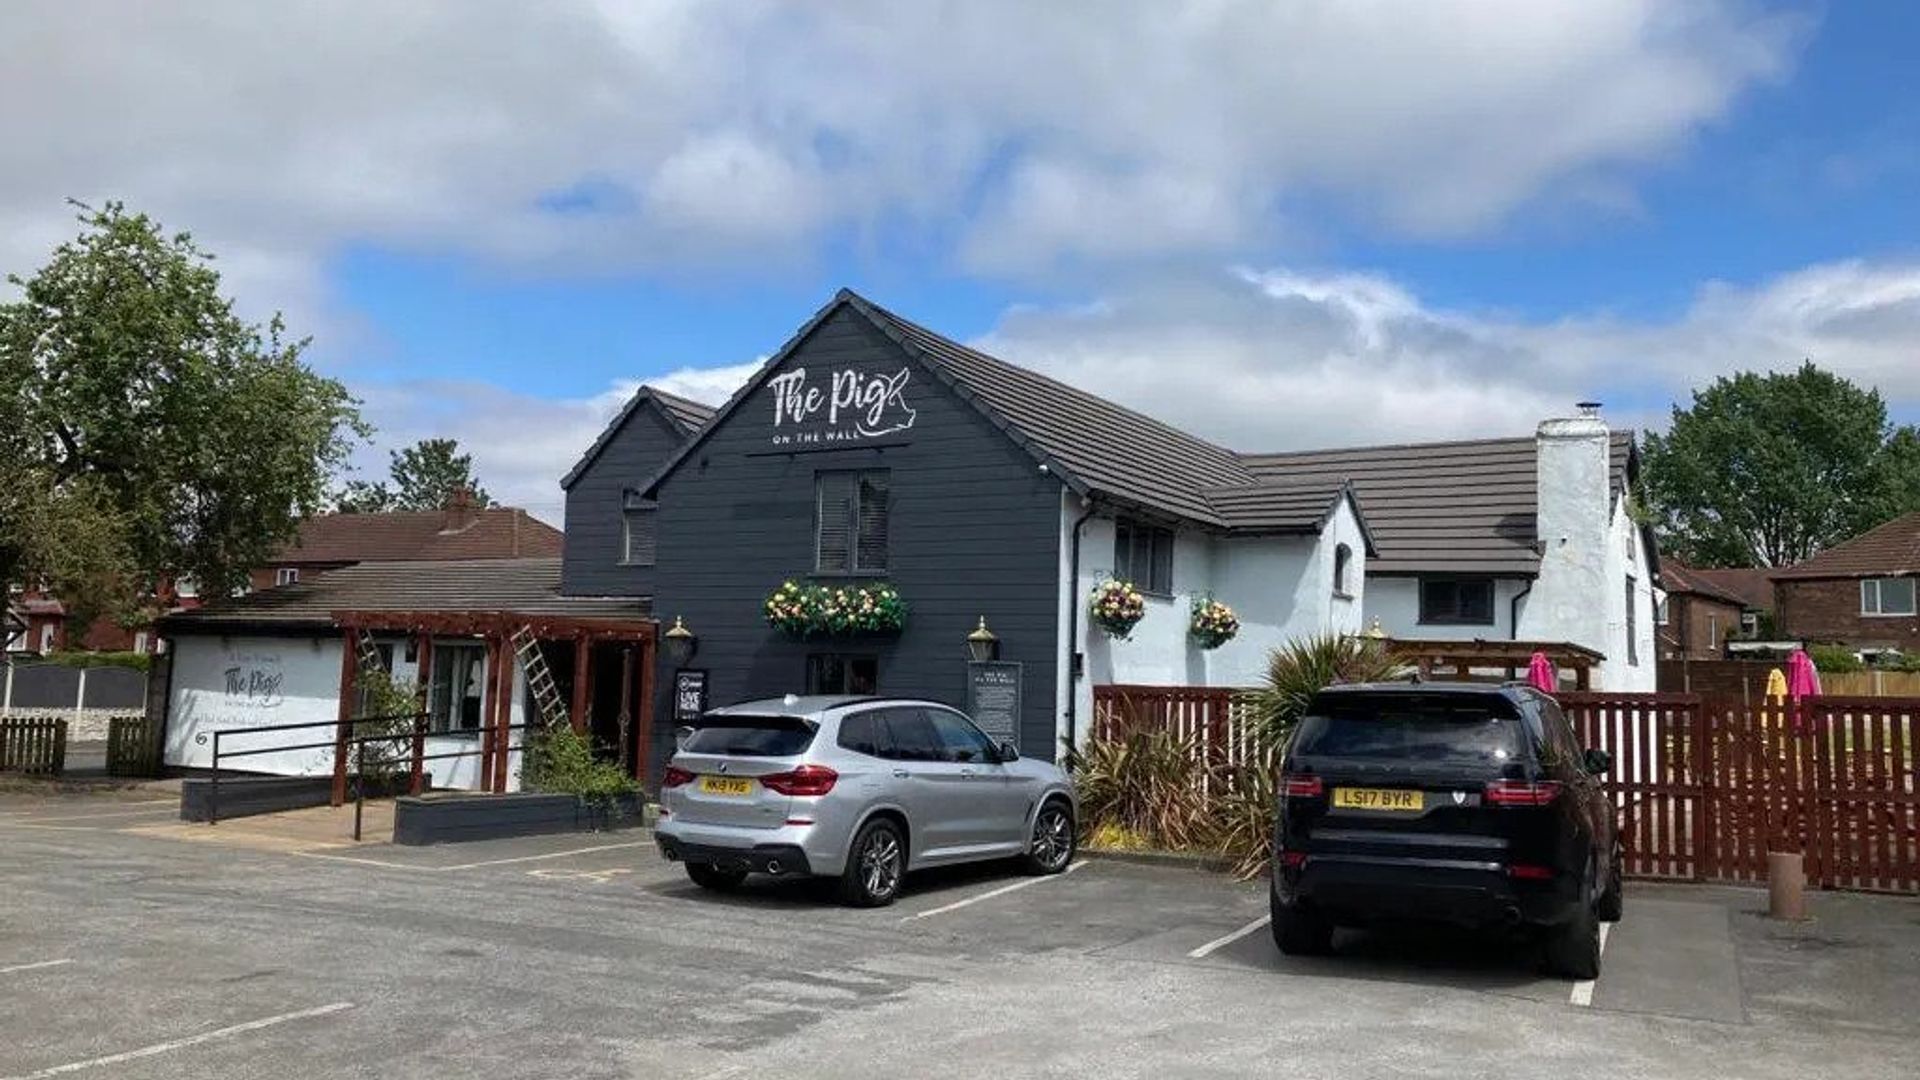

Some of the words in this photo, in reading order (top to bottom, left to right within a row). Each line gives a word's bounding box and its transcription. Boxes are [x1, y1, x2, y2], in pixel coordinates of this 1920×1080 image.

[767, 367, 824, 427] The
[829, 370, 887, 426] Pig
[772, 434, 790, 444] ON
[796, 432, 819, 442] THE
[826, 430, 861, 440] WALL
[1344, 789, 1378, 806] LS17
[1382, 790, 1412, 807] BYR
